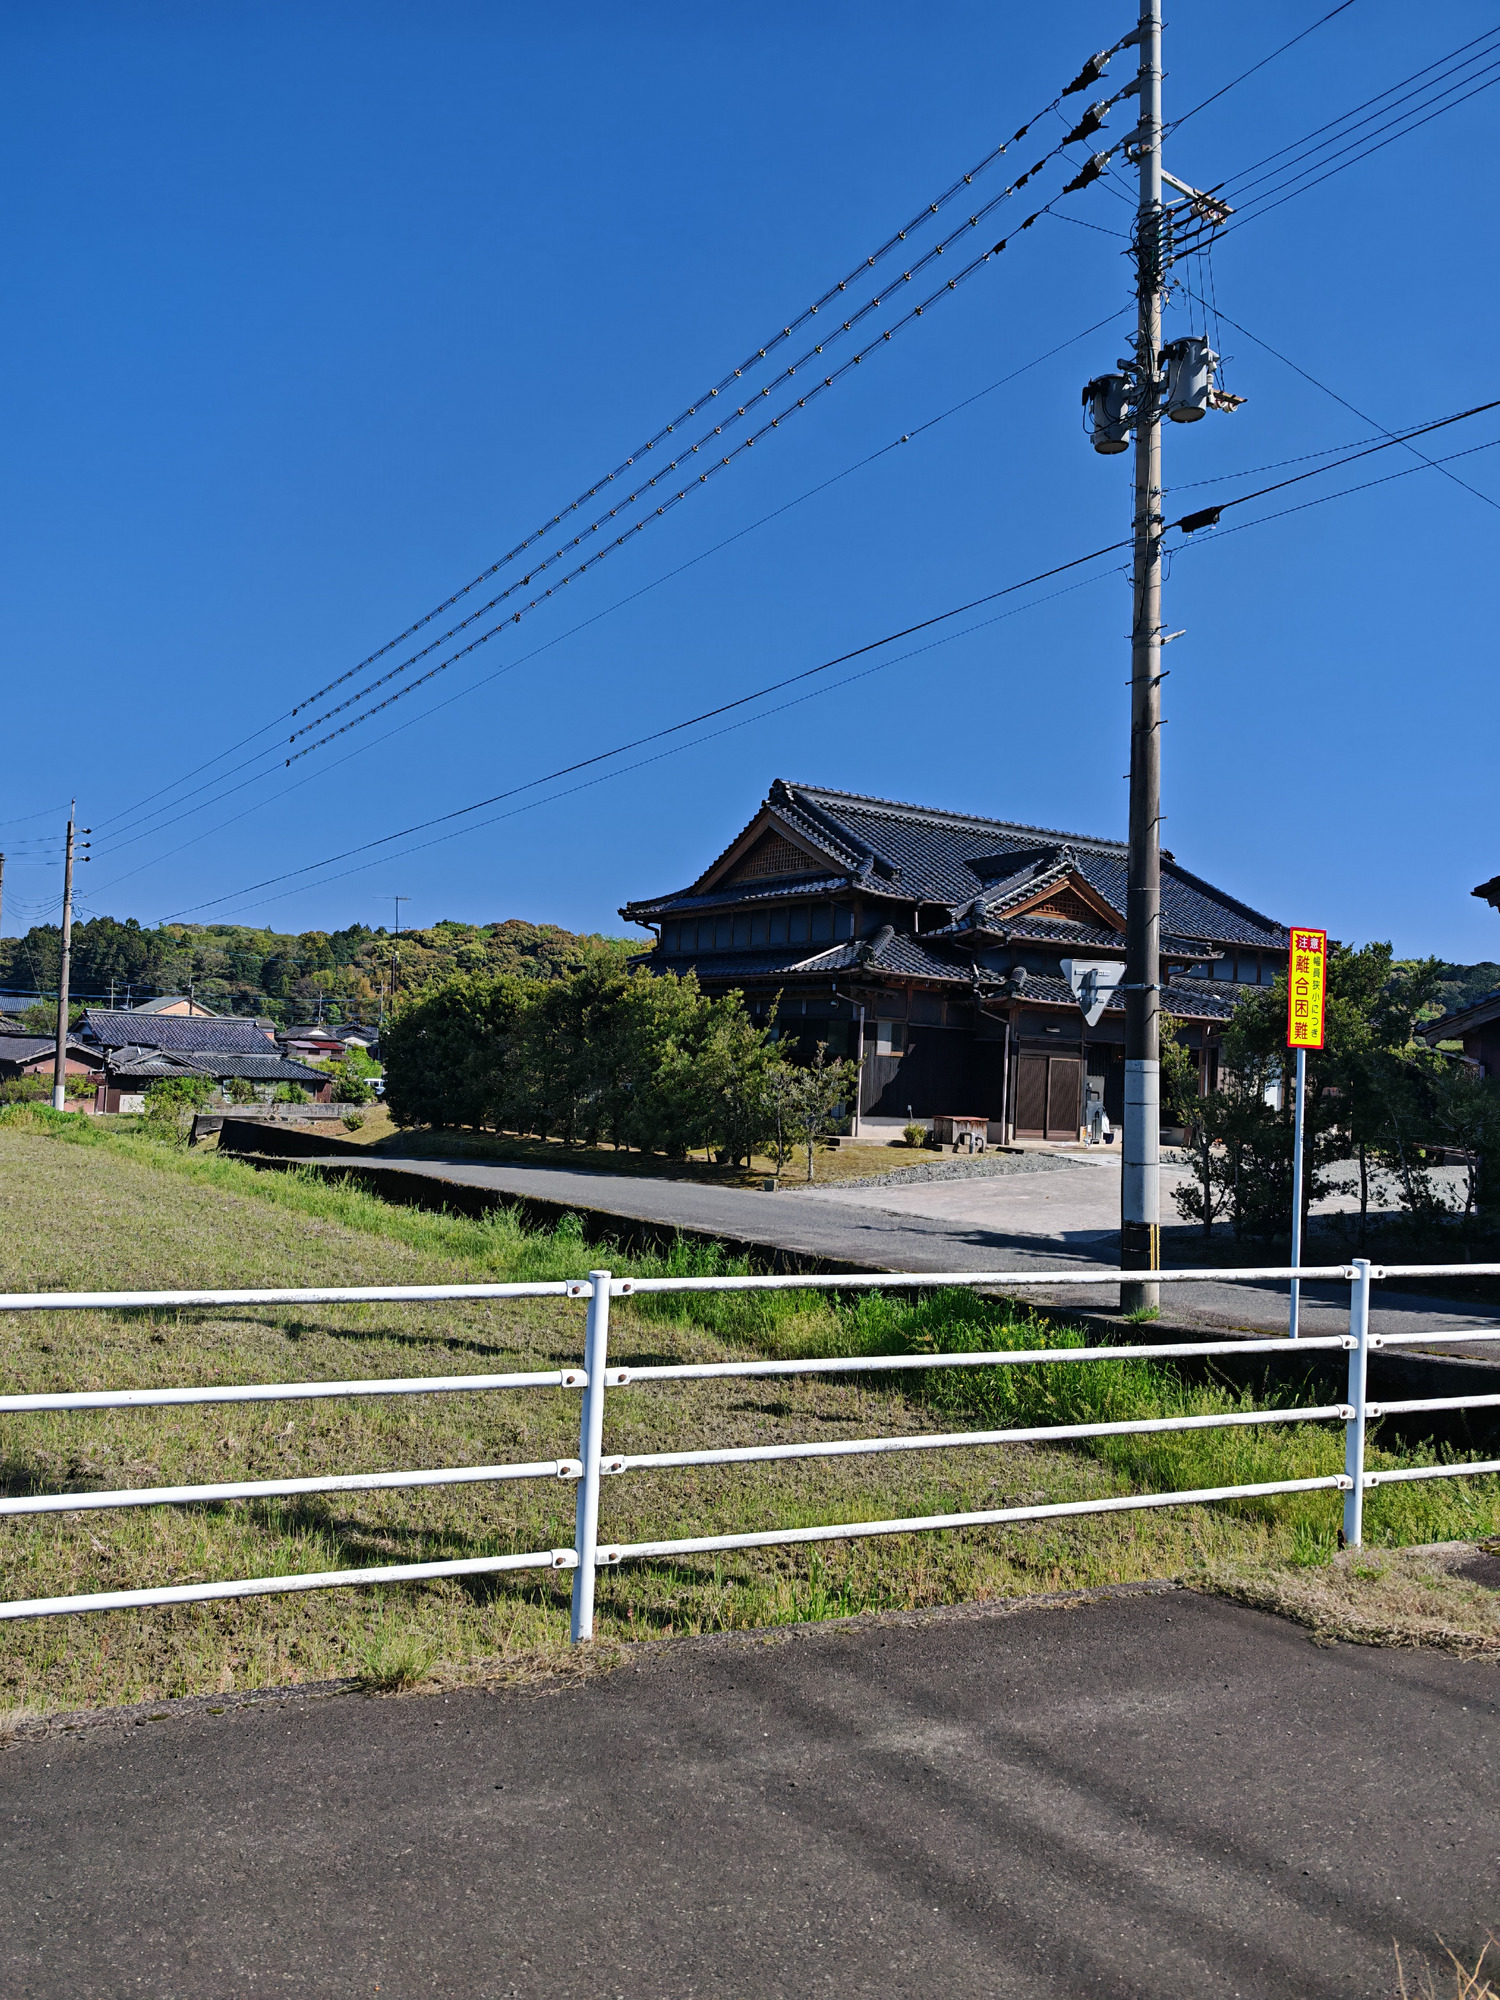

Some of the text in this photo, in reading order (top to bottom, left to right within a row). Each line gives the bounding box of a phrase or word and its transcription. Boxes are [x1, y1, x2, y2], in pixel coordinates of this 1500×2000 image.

[1299, 937, 1319, 949] 注意
[1294, 955, 1310, 1040] 離合困難
[1311, 956, 1321, 1038] 幅員狭小につき
